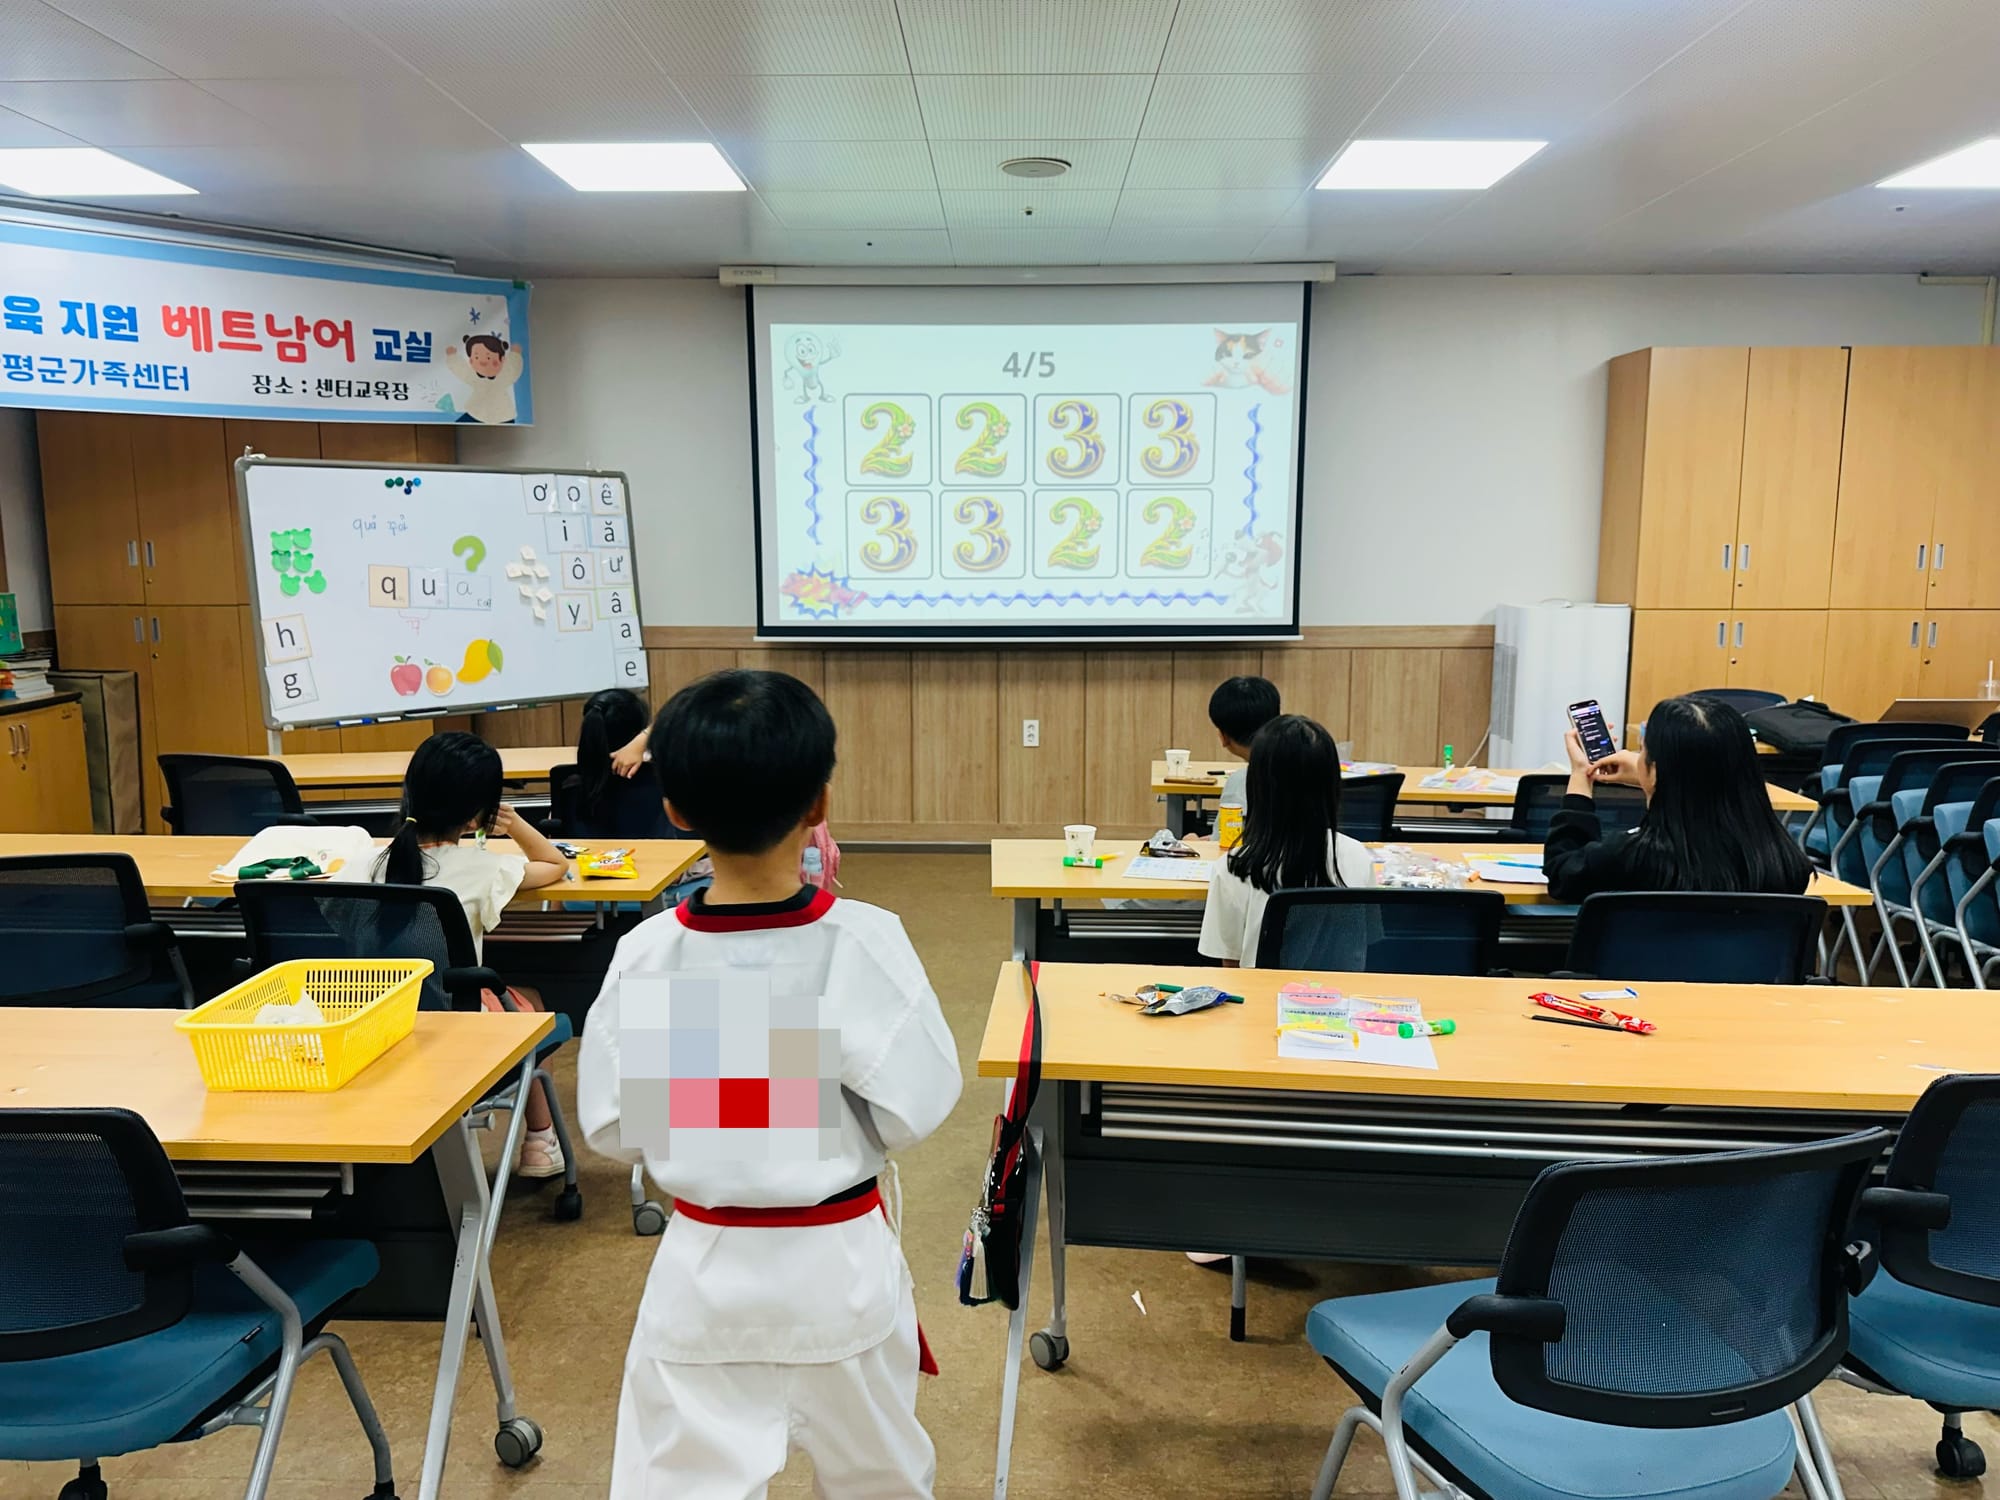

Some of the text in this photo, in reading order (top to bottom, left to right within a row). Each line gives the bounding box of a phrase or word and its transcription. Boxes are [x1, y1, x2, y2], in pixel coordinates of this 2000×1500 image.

[59, 300, 139, 342] 지원
[161, 304, 355, 363] 베트남어
[372, 328, 433, 363] 교실
[0, 353, 190, 391] 평군가족센터
[1002, 351, 1056, 378] 4/5
[252, 374, 294, 395] 장소
[315, 378, 409, 400] 센터교육장
[860, 399, 1199, 478] 2 2 3 3
[567, 485, 581, 502] o
[601, 482, 614, 506] ê
[562, 519, 615, 543] i ă
[859, 496, 1197, 572] 3 3 2 2
[572, 556, 585, 580] ô
[568, 591, 622, 625] y â
[276, 622, 295, 648] h
[620, 622, 632, 638] a
[625, 660, 637, 677] e
[283, 673, 302, 699] g
